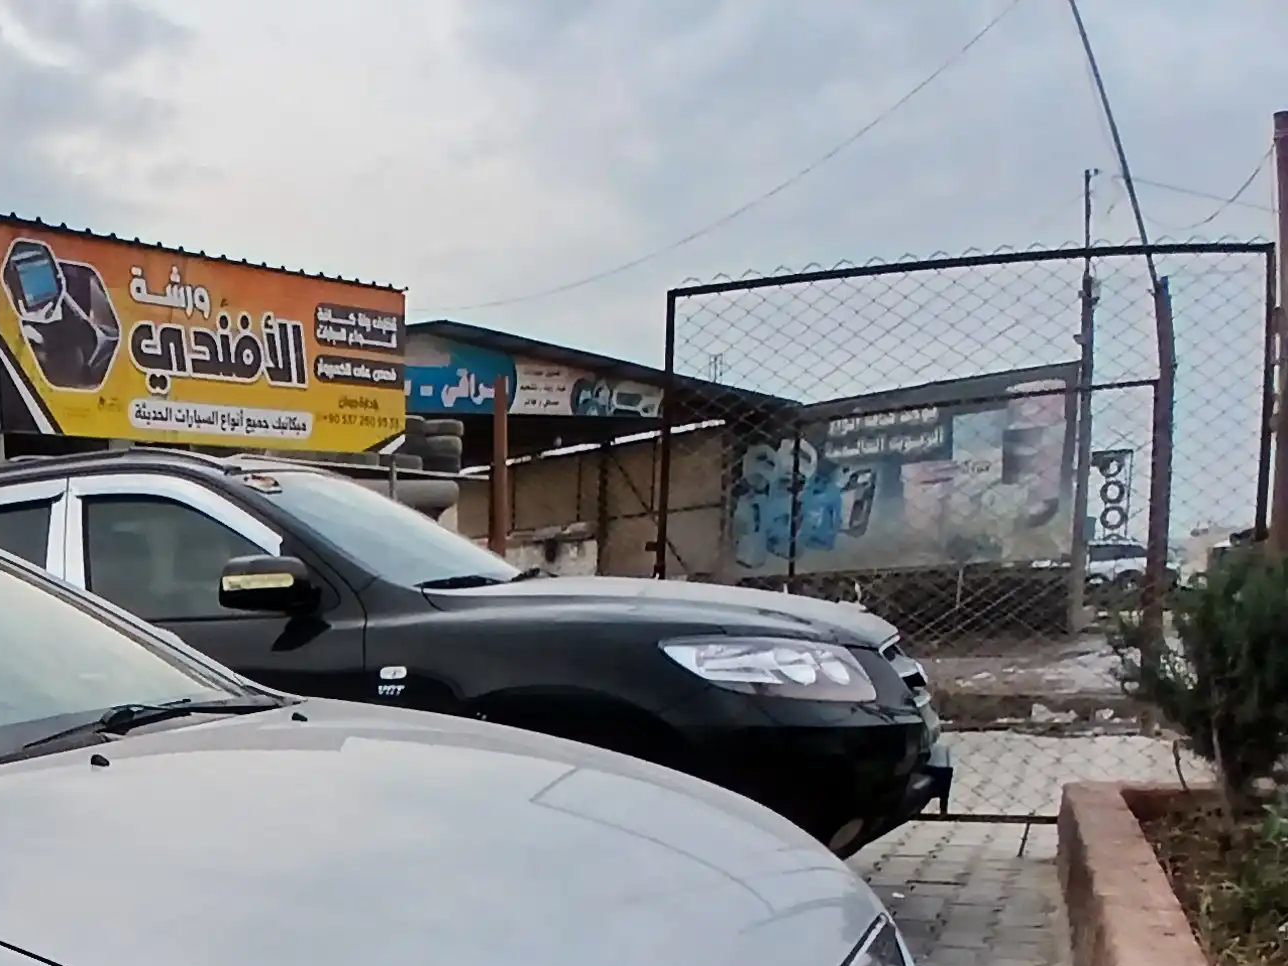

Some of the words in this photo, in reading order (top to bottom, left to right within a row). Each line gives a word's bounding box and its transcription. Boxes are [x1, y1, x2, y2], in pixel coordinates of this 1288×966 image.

[130, 266, 211, 320] ورشة
[129, 311, 308, 394] الأفندي
[134, 402, 173, 425] الحديثة
[175, 408, 218, 429] السيارات
[220, 410, 244, 432] أنواع
[245, 417, 269, 434] جميع
[272, 417, 307, 436] ميكانيك
